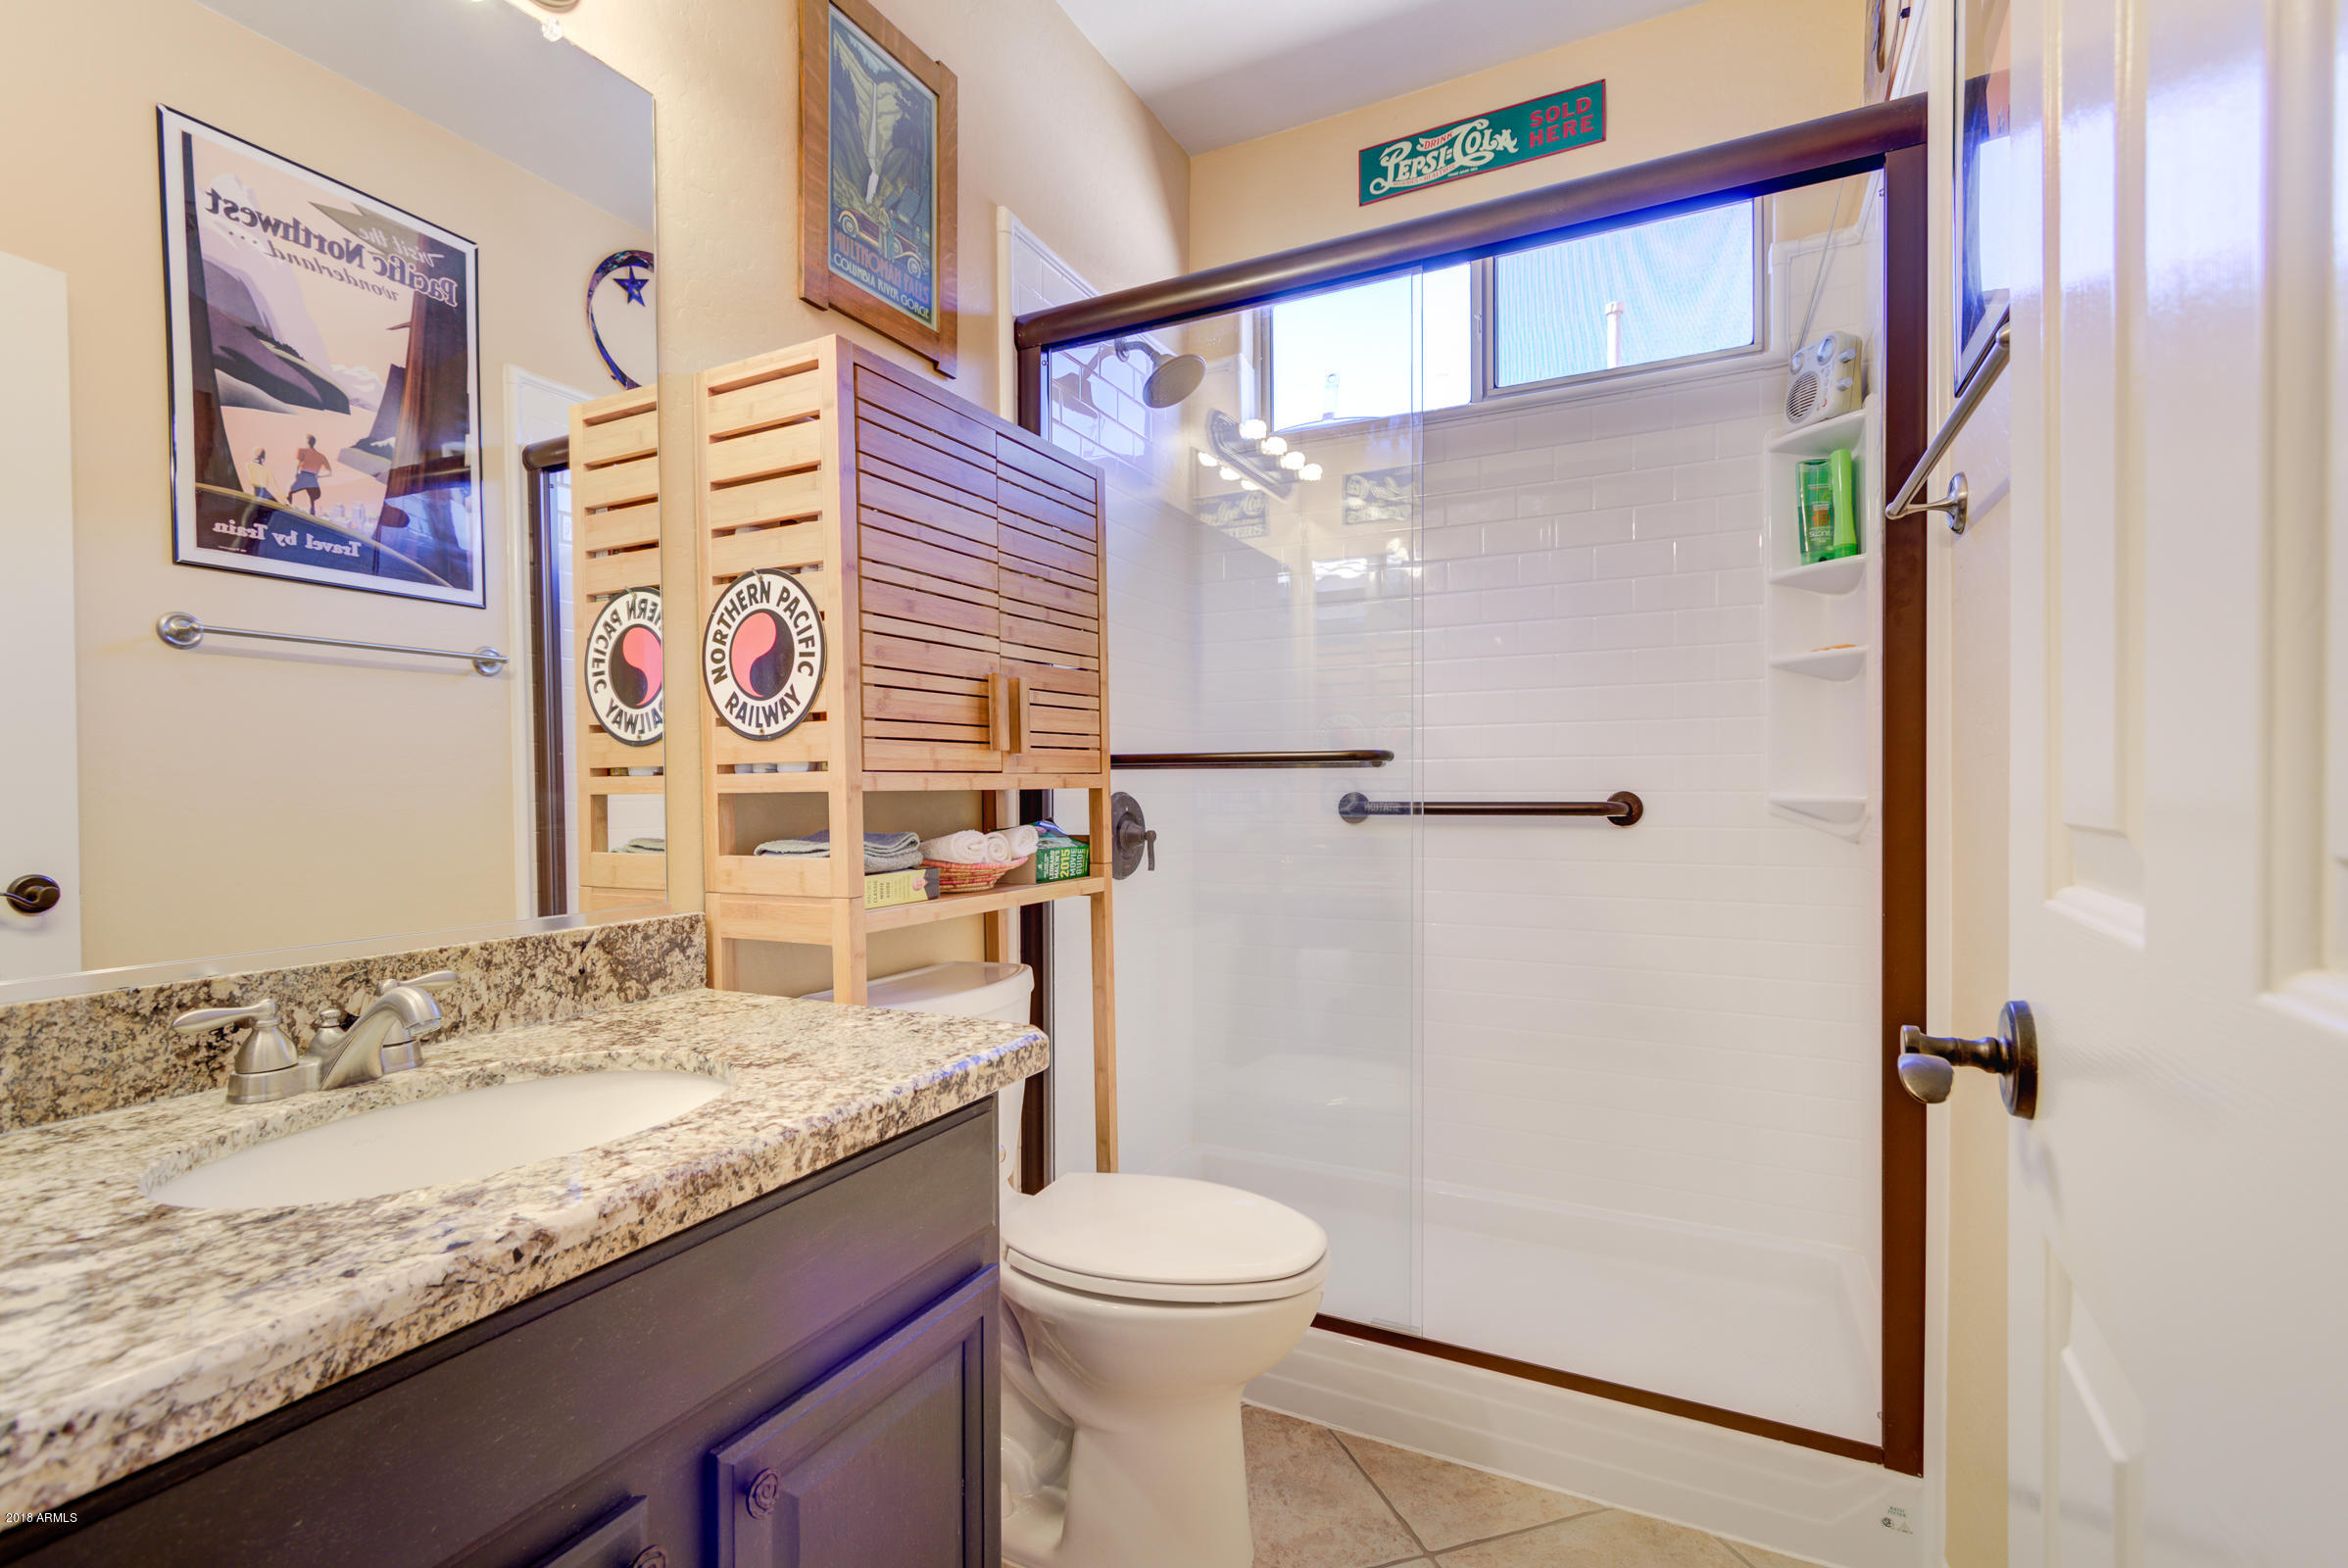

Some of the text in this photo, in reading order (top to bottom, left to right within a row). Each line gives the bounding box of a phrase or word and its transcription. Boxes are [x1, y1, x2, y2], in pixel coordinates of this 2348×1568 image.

[1529, 96, 1592, 127] SOLD
[1424, 131, 1453, 150] DRINK
[1529, 114, 1594, 149] HERE
[833, 252, 930, 319] COLUMBIA RIVER GORGE
[710, 580, 816, 686] NORTHERN PACIFIC
[724, 683, 802, 729] RAILWAY
[1059, 849, 1070, 878] 2015
